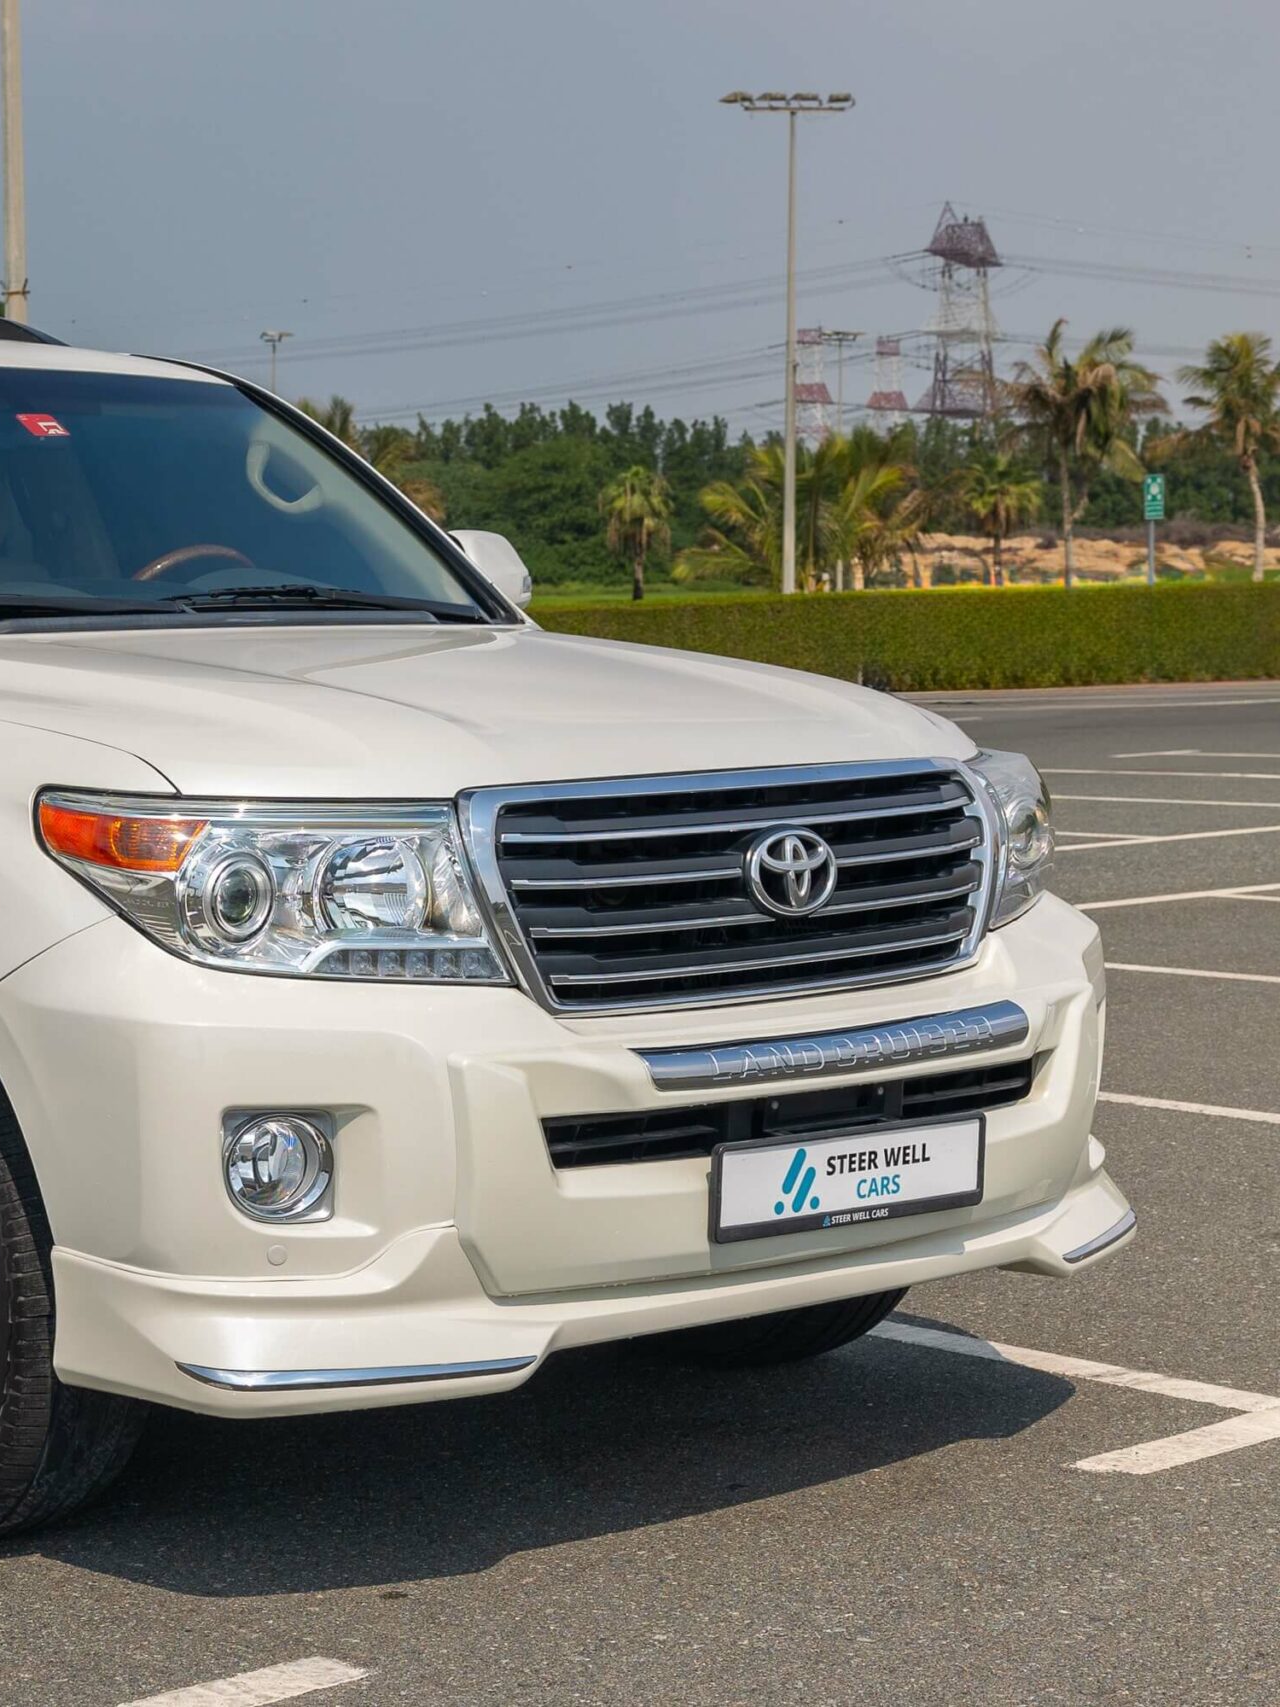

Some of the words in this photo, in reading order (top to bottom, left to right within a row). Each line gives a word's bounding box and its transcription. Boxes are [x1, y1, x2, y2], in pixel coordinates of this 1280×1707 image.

[705, 1043, 825, 1081] LAND
[831, 1015, 994, 1068] CRUISER
[826, 1150, 879, 1176] STEER
[884, 1142, 931, 1168] WELL
[856, 1174, 901, 1199] CARS
[831, 1213, 851, 1225] STEER
[852, 1210, 870, 1221] WELL
[871, 1208, 889, 1218] CARS
